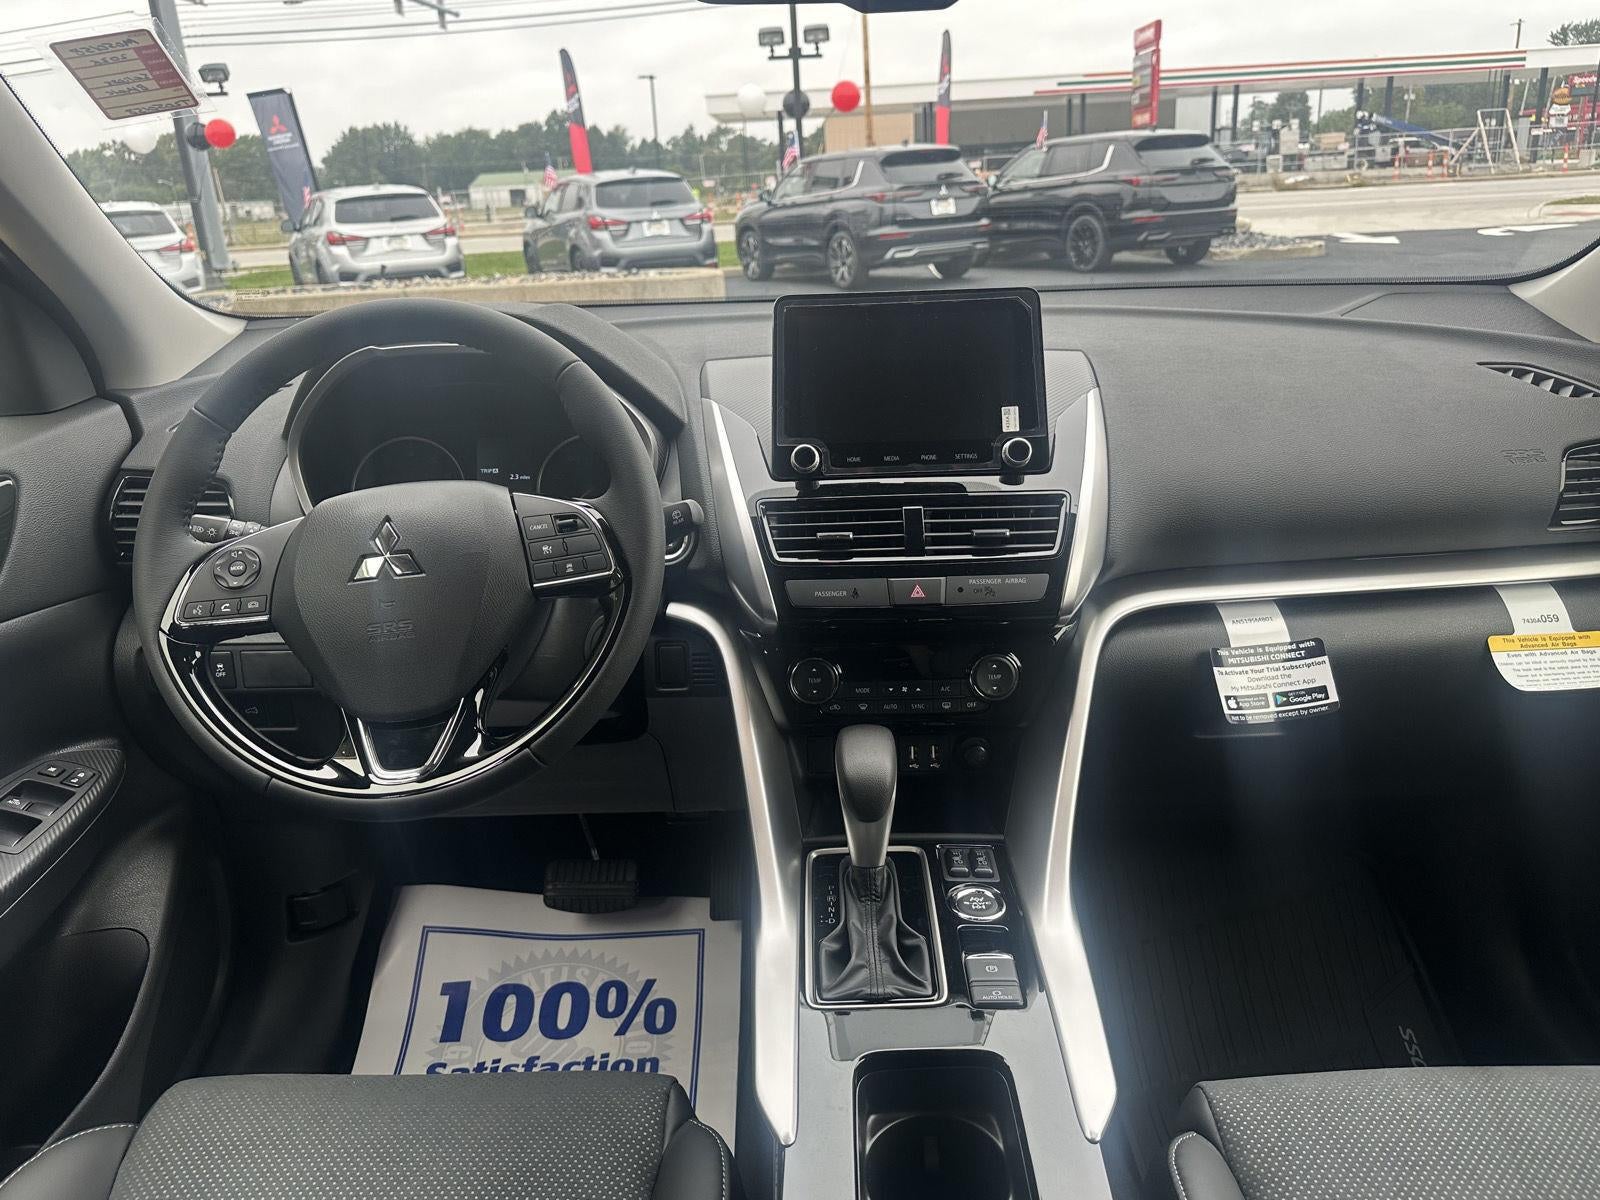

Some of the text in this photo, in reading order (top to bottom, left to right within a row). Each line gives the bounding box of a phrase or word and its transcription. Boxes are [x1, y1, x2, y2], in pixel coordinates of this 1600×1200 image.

[1005, 577, 1027, 585] AIRBAG
[1230, 647, 1255, 655] Vehicle
[1265, 643, 1297, 653] Equipped
[1298, 640, 1316, 648] with
[1228, 650, 1305, 664] MITSUBISHI CONNECT
[1266, 665, 1281, 673] Trial
[1282, 659, 1327, 671] Subscription
[1240, 682, 1271, 691] Mitsubishi
[1272, 680, 1301, 689] Connect
[1302, 677, 1317, 685] App
[1247, 674, 1279, 683] Download
[1289, 692, 1326, 703] Google Play
[1252, 711, 1278, 720] removed
[1278, 709, 1299, 719] except
[1300, 708, 1308, 716] by
[1309, 705, 1329, 713] owner
[439, 978, 677, 1043] 100%
